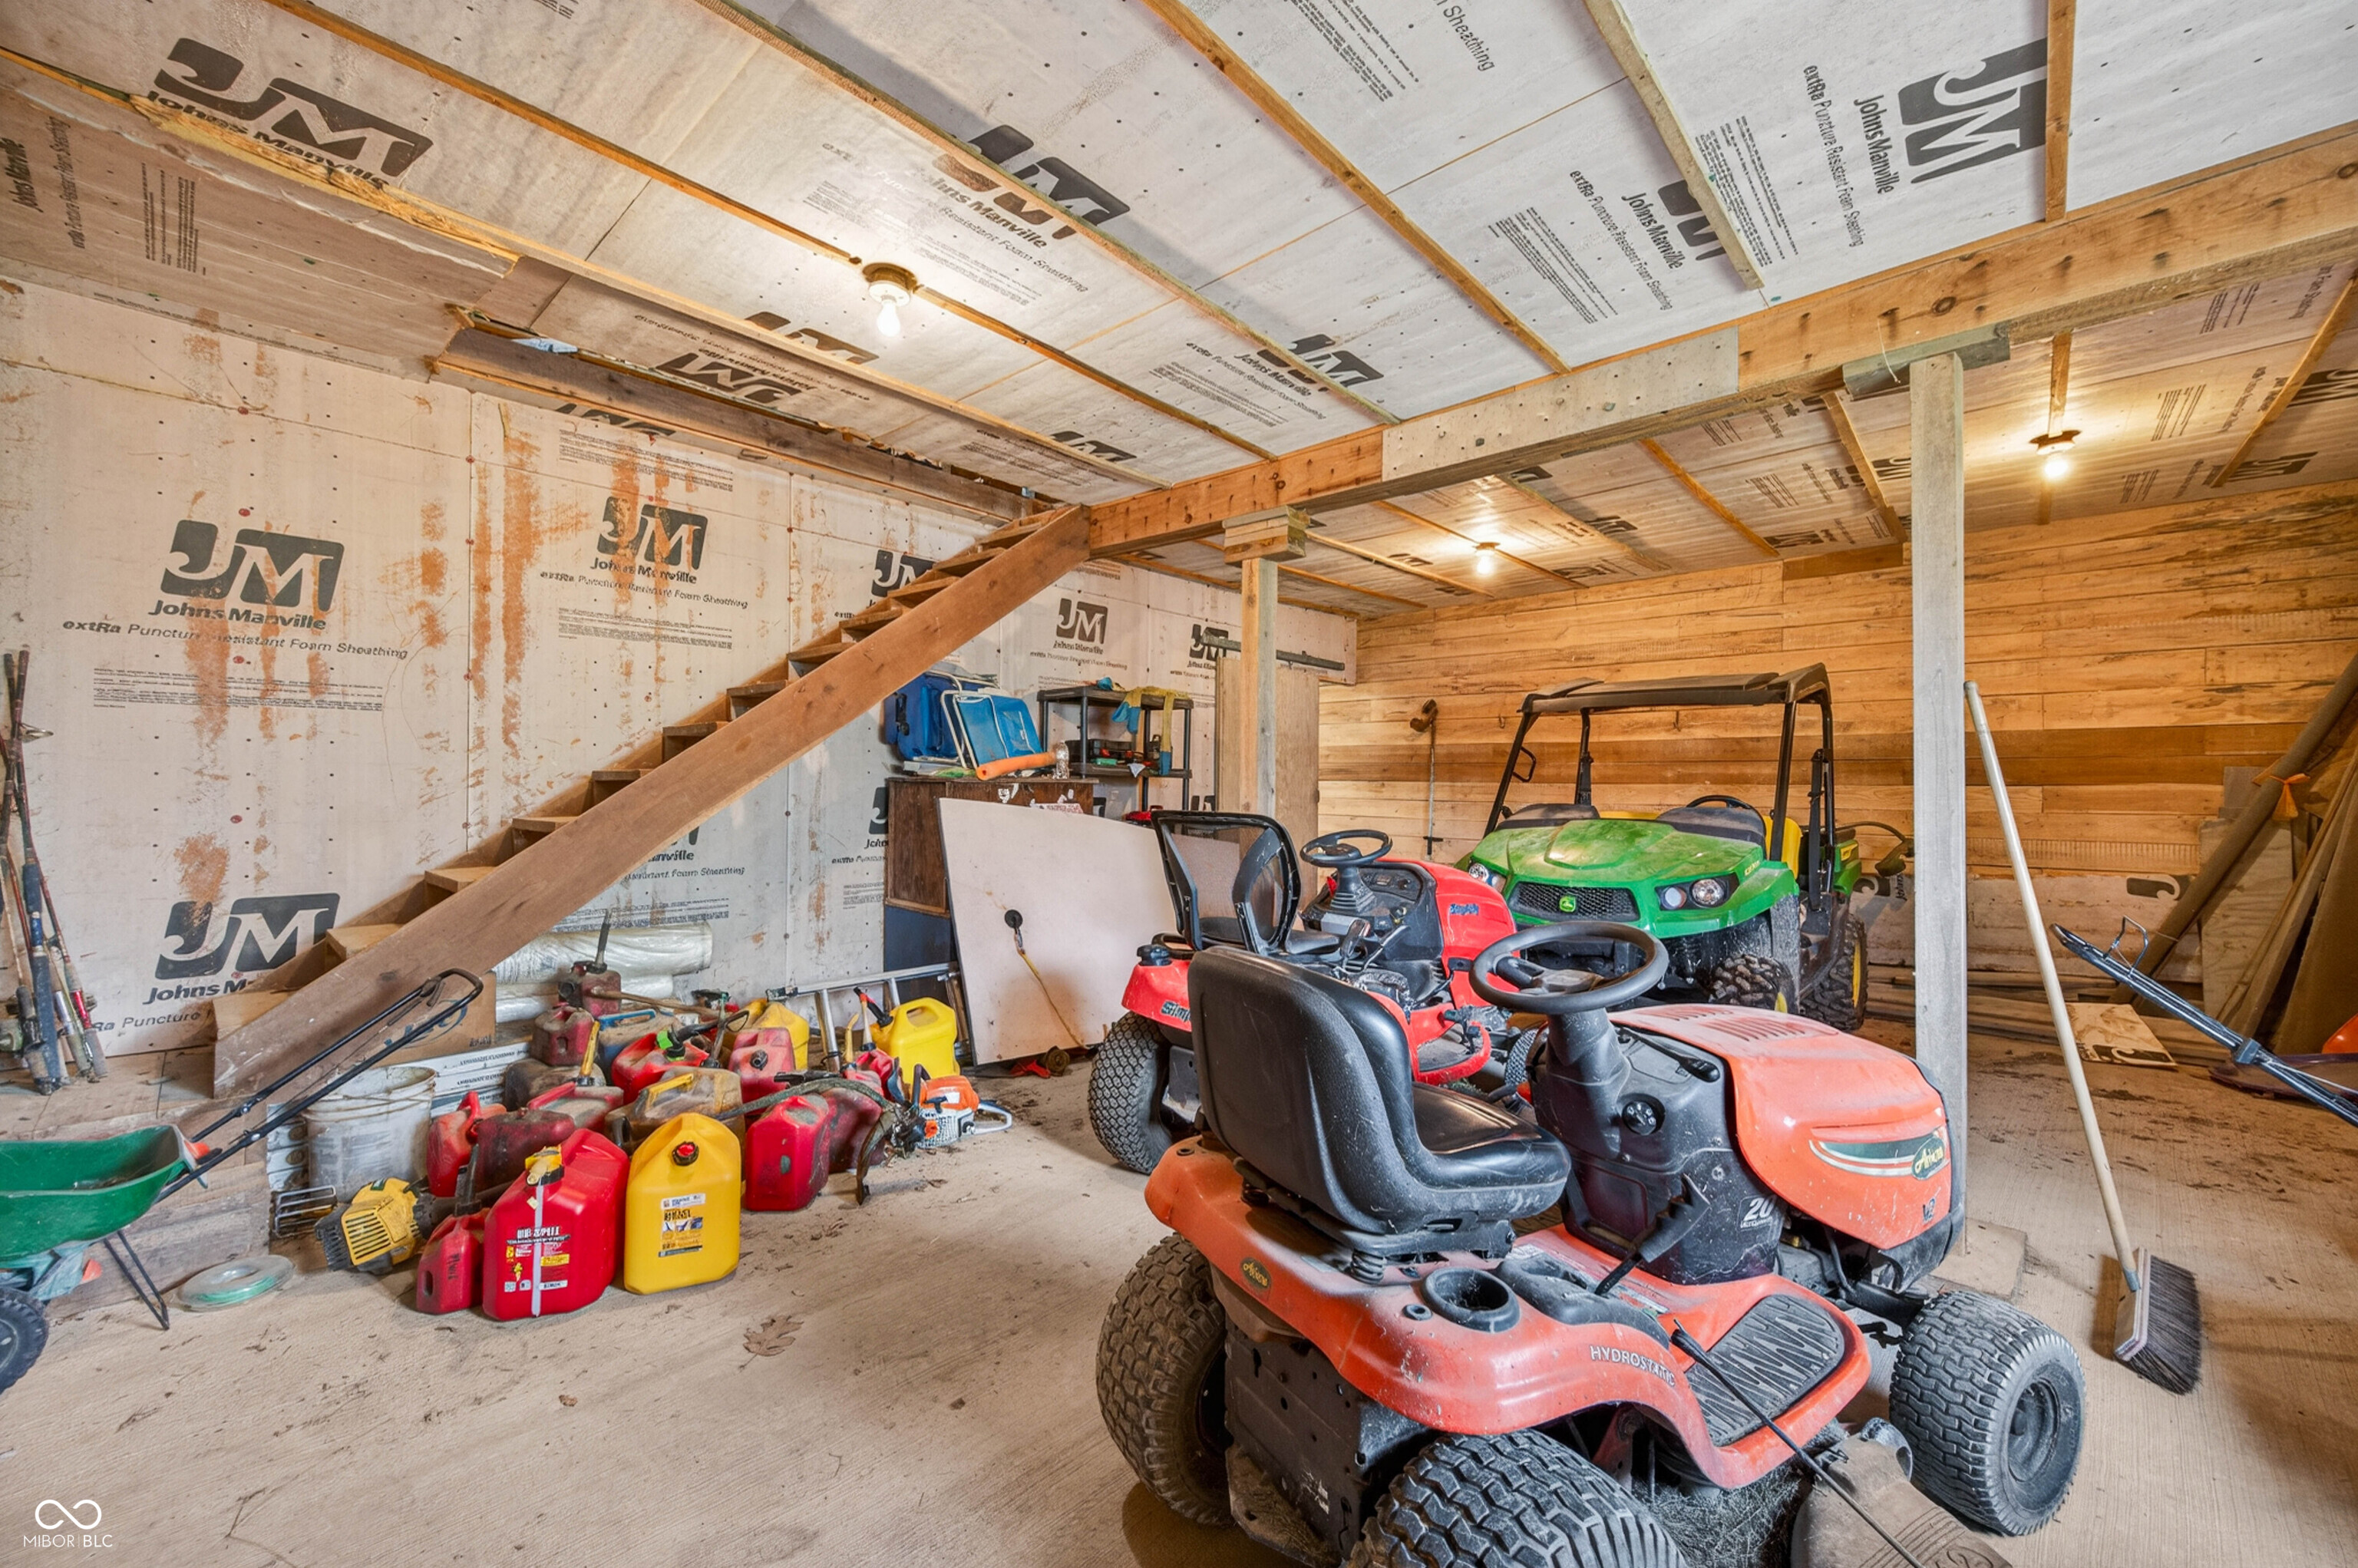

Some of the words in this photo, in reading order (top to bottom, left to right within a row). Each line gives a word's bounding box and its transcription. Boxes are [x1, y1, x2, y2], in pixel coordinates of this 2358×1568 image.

[1442, 5, 1495, 72] Sheathing
[154, 38, 433, 177] JM
[1853, 94, 1887, 141] Johns
[1897, 37, 2048, 185] JM
[1867, 137, 1901, 194] Manville
[967, 200, 1048, 249] Manville
[597, 496, 708, 570] JM
[160, 519, 345, 612] JM
[148, 599, 225, 619] Johns
[228, 607, 327, 631] Manville
[1055, 597, 1108, 645] JM
[62, 619, 121, 635] extRa
[127, 623, 205, 640] Punctur
[289, 638, 332, 653] Foam
[336, 642, 408, 660] Sheathing
[647, 850, 695, 863] nville
[154, 892, 341, 981] JM
[142, 982, 221, 1005] Johns
[121, 1012, 202, 1029] Puncture
[1743, 1197, 1775, 1222] 20
[1589, 1345, 1676, 1387] HYDROSTATIC
